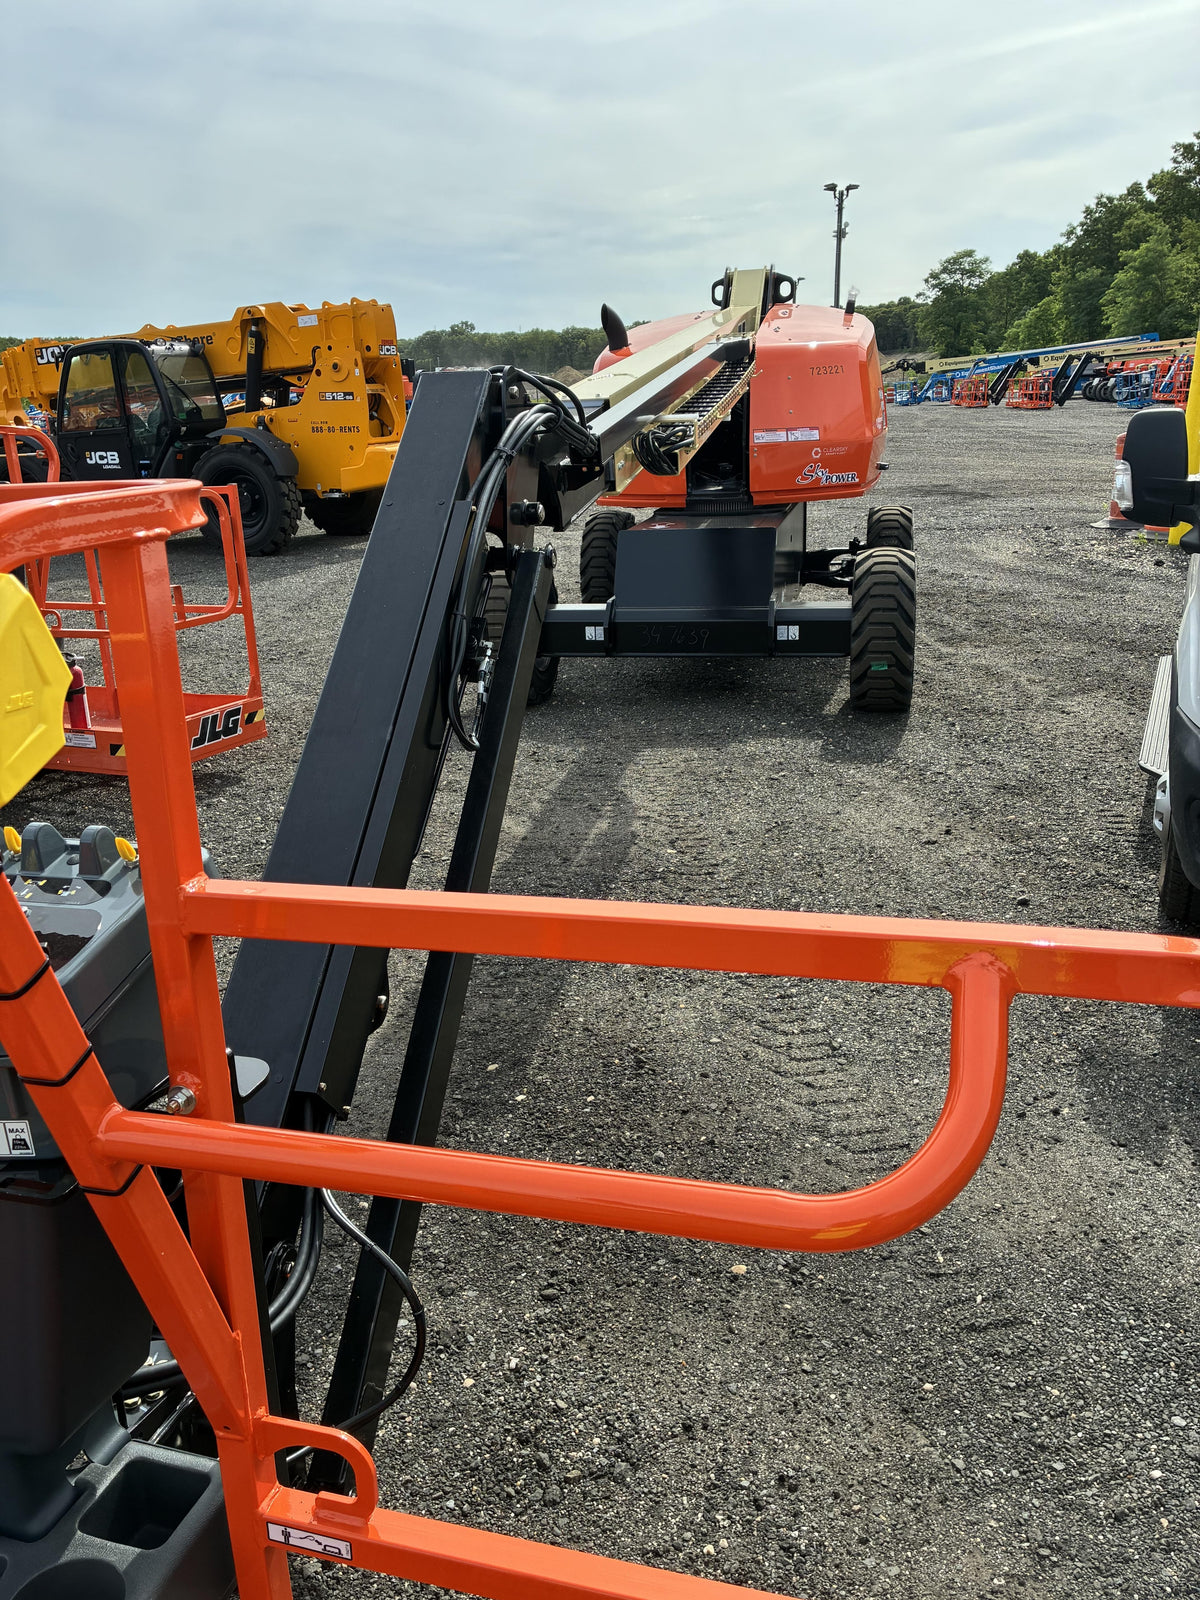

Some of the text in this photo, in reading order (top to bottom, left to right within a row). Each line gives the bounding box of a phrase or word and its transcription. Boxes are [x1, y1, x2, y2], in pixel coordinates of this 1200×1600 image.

[36, 345, 65, 364] JC
[380, 345, 397, 355] JCB
[809, 365, 845, 376] 723221
[86, 451, 120, 464] JCB
[190, 705, 243, 750] JLG
